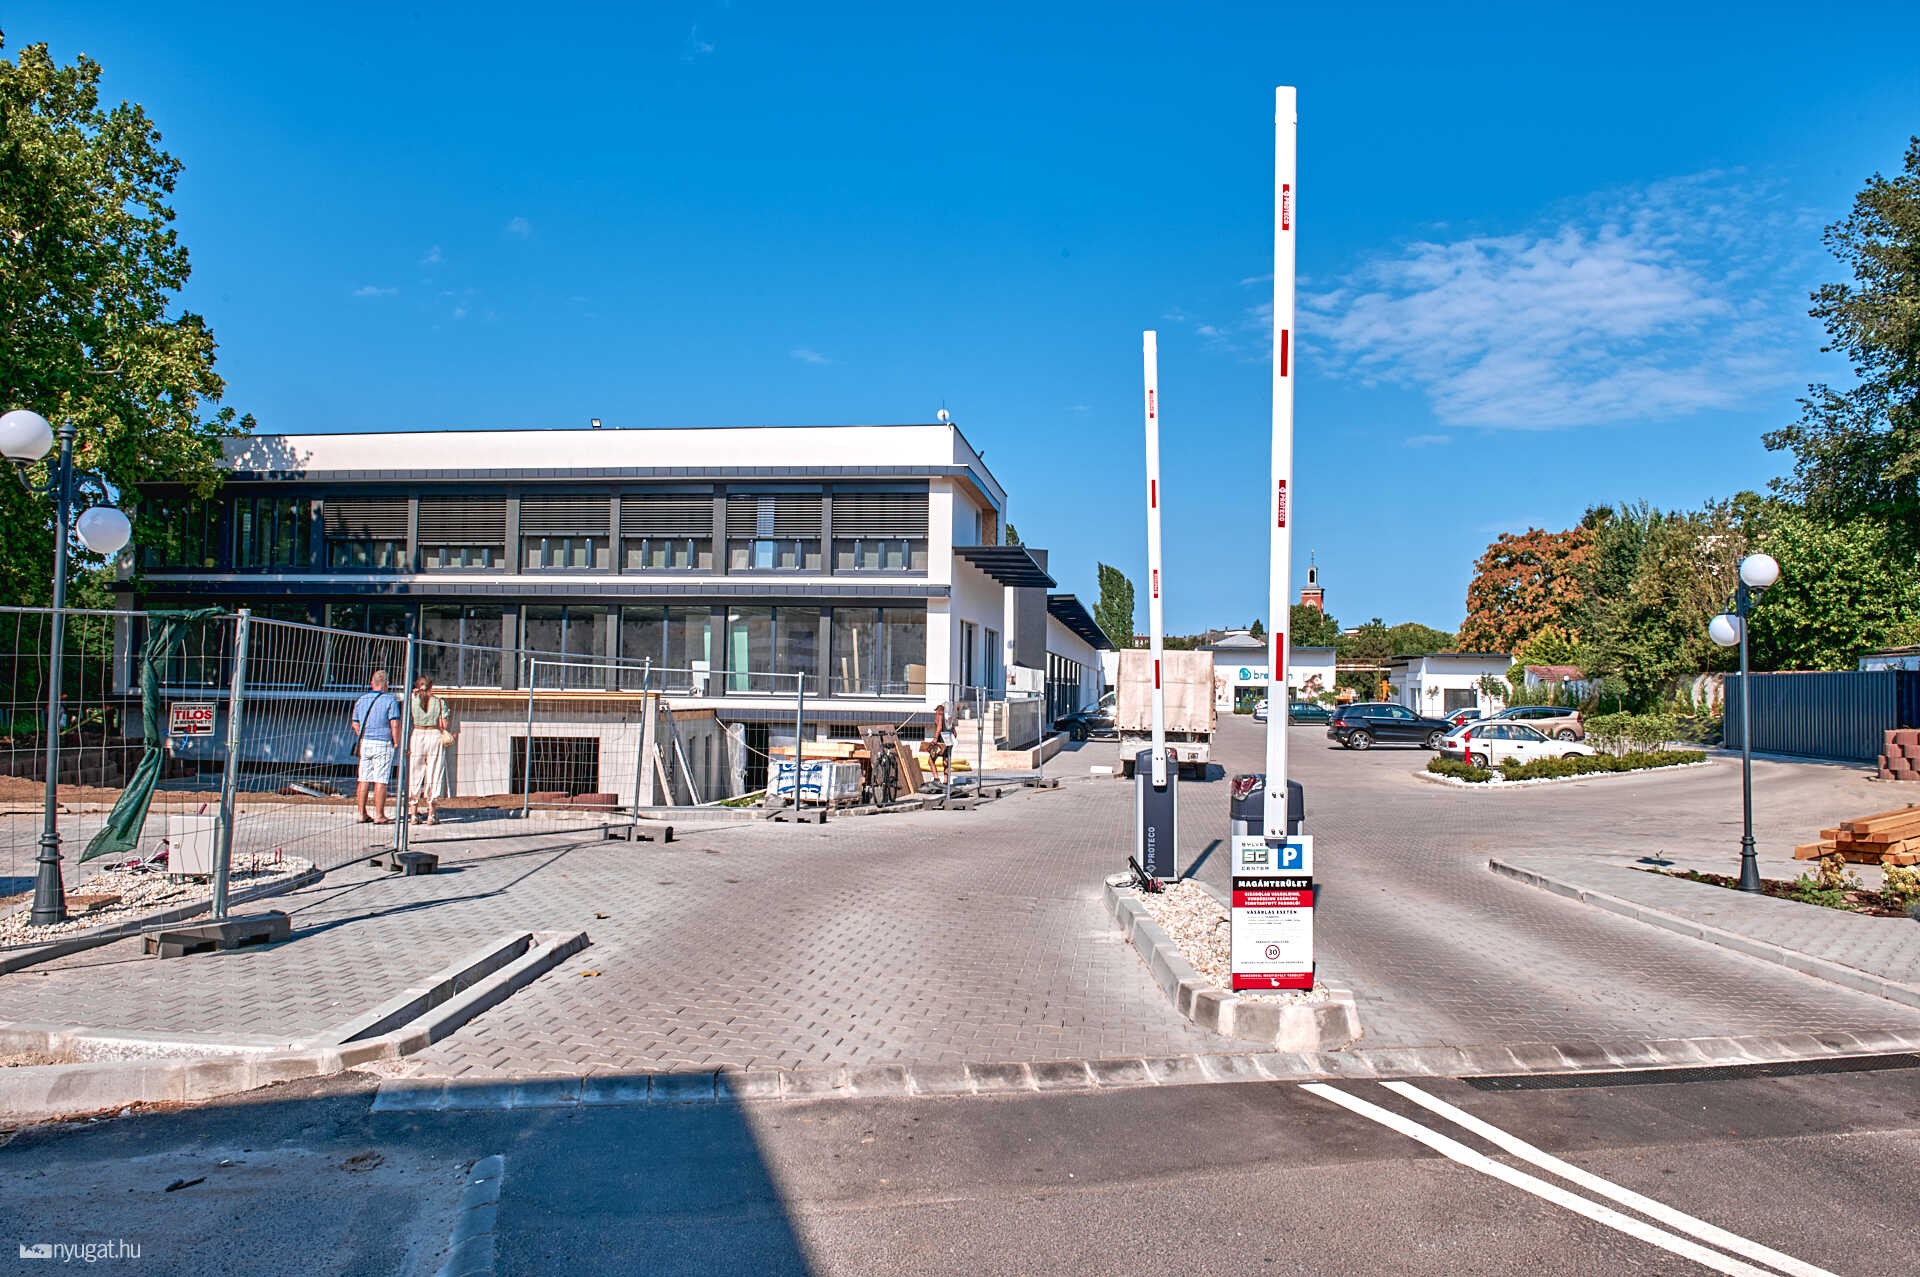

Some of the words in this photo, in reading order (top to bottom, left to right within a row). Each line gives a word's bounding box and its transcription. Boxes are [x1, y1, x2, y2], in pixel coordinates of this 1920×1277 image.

[1254, 669, 1293, 680] bren
[174, 710, 212, 720] TILOS
[1147, 826, 1156, 864] PROTECO
[1243, 851, 1266, 862] SC
[1282, 847, 1298, 867] P
[1238, 878, 1308, 888] MAGÁNTERÜLET
[1268, 948, 1278, 956] 30
